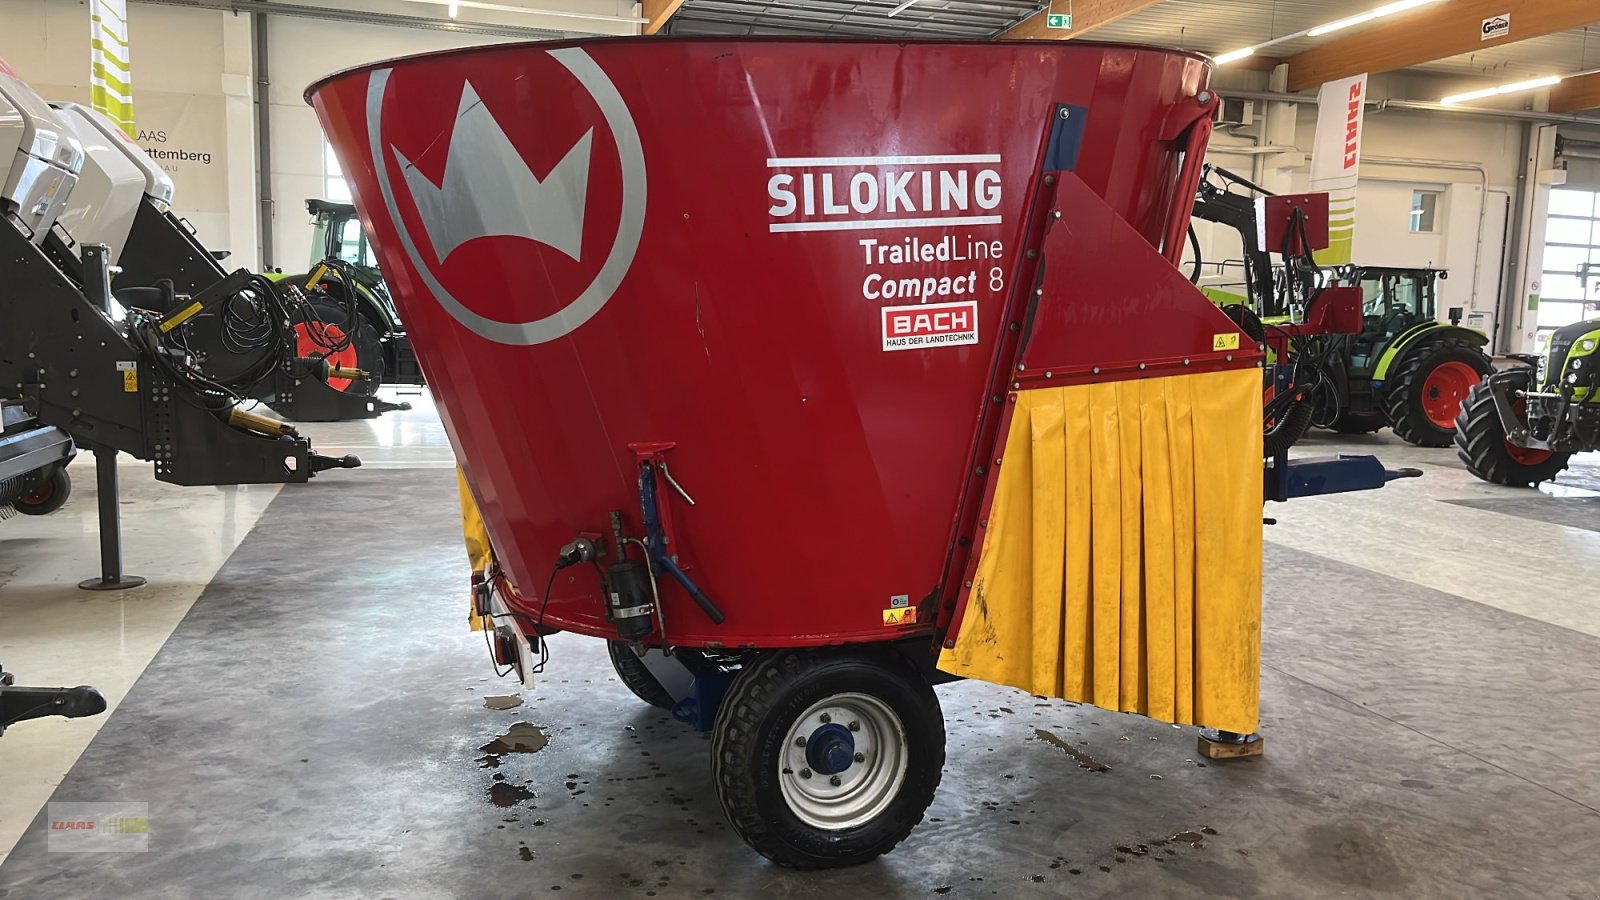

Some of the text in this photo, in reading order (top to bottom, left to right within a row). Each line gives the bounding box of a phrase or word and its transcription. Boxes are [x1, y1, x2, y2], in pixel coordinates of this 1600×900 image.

[136, 129, 167, 143] AAS
[767, 169, 1002, 217] SILOKING
[859, 234, 1003, 265] TrailedLine
[862, 266, 1004, 304] Compact 8
[893, 311, 967, 334] BACH
[886, 332, 975, 347] HAUS DER LANDTECHNIK
